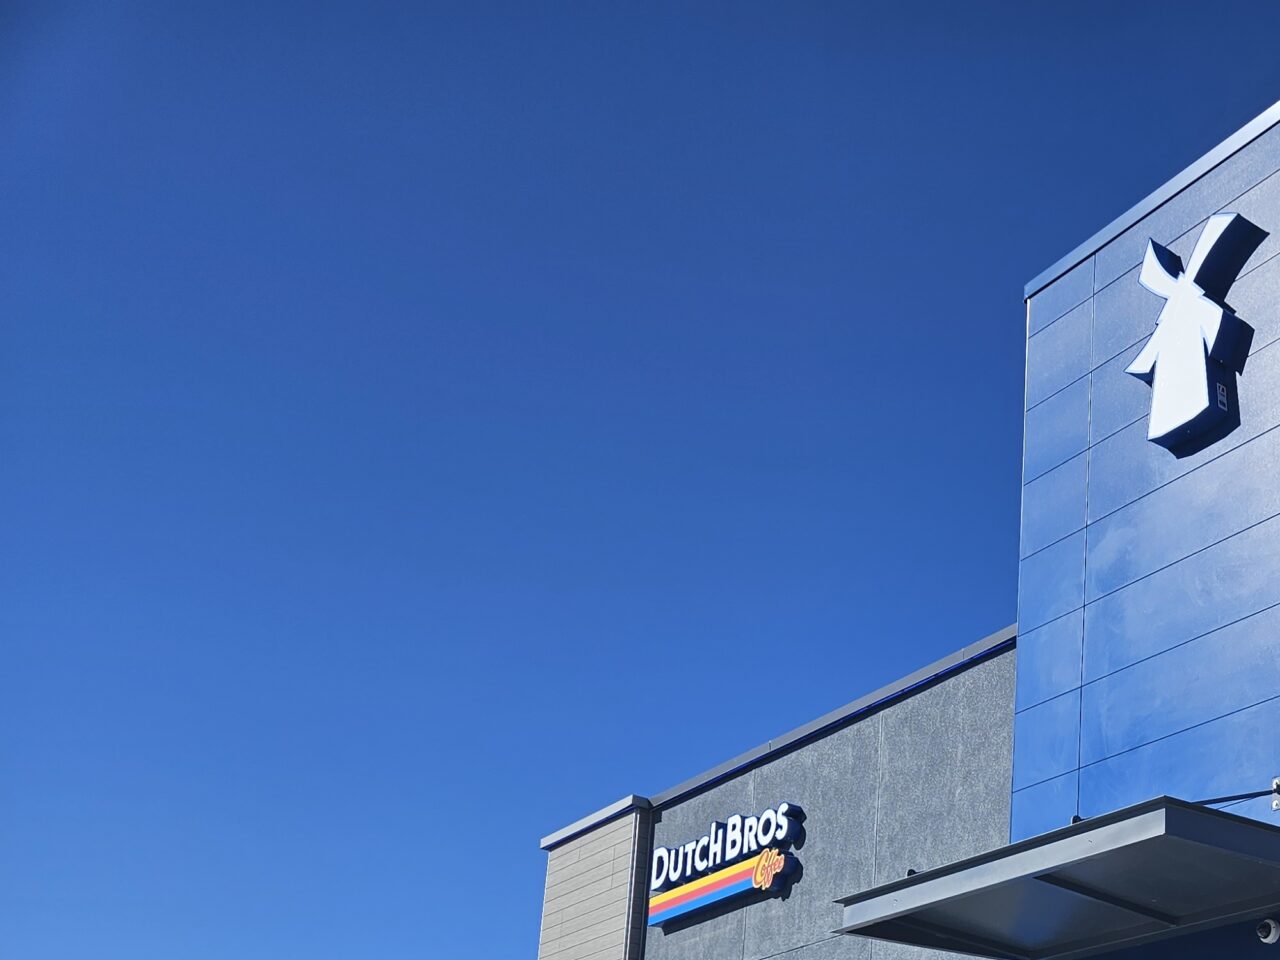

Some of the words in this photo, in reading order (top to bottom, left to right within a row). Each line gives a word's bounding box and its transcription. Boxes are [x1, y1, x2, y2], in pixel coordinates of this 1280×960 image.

[650, 821, 724, 891] DUTCH
[725, 802, 789, 862] BROS
[752, 848, 785, 890] Coffee
